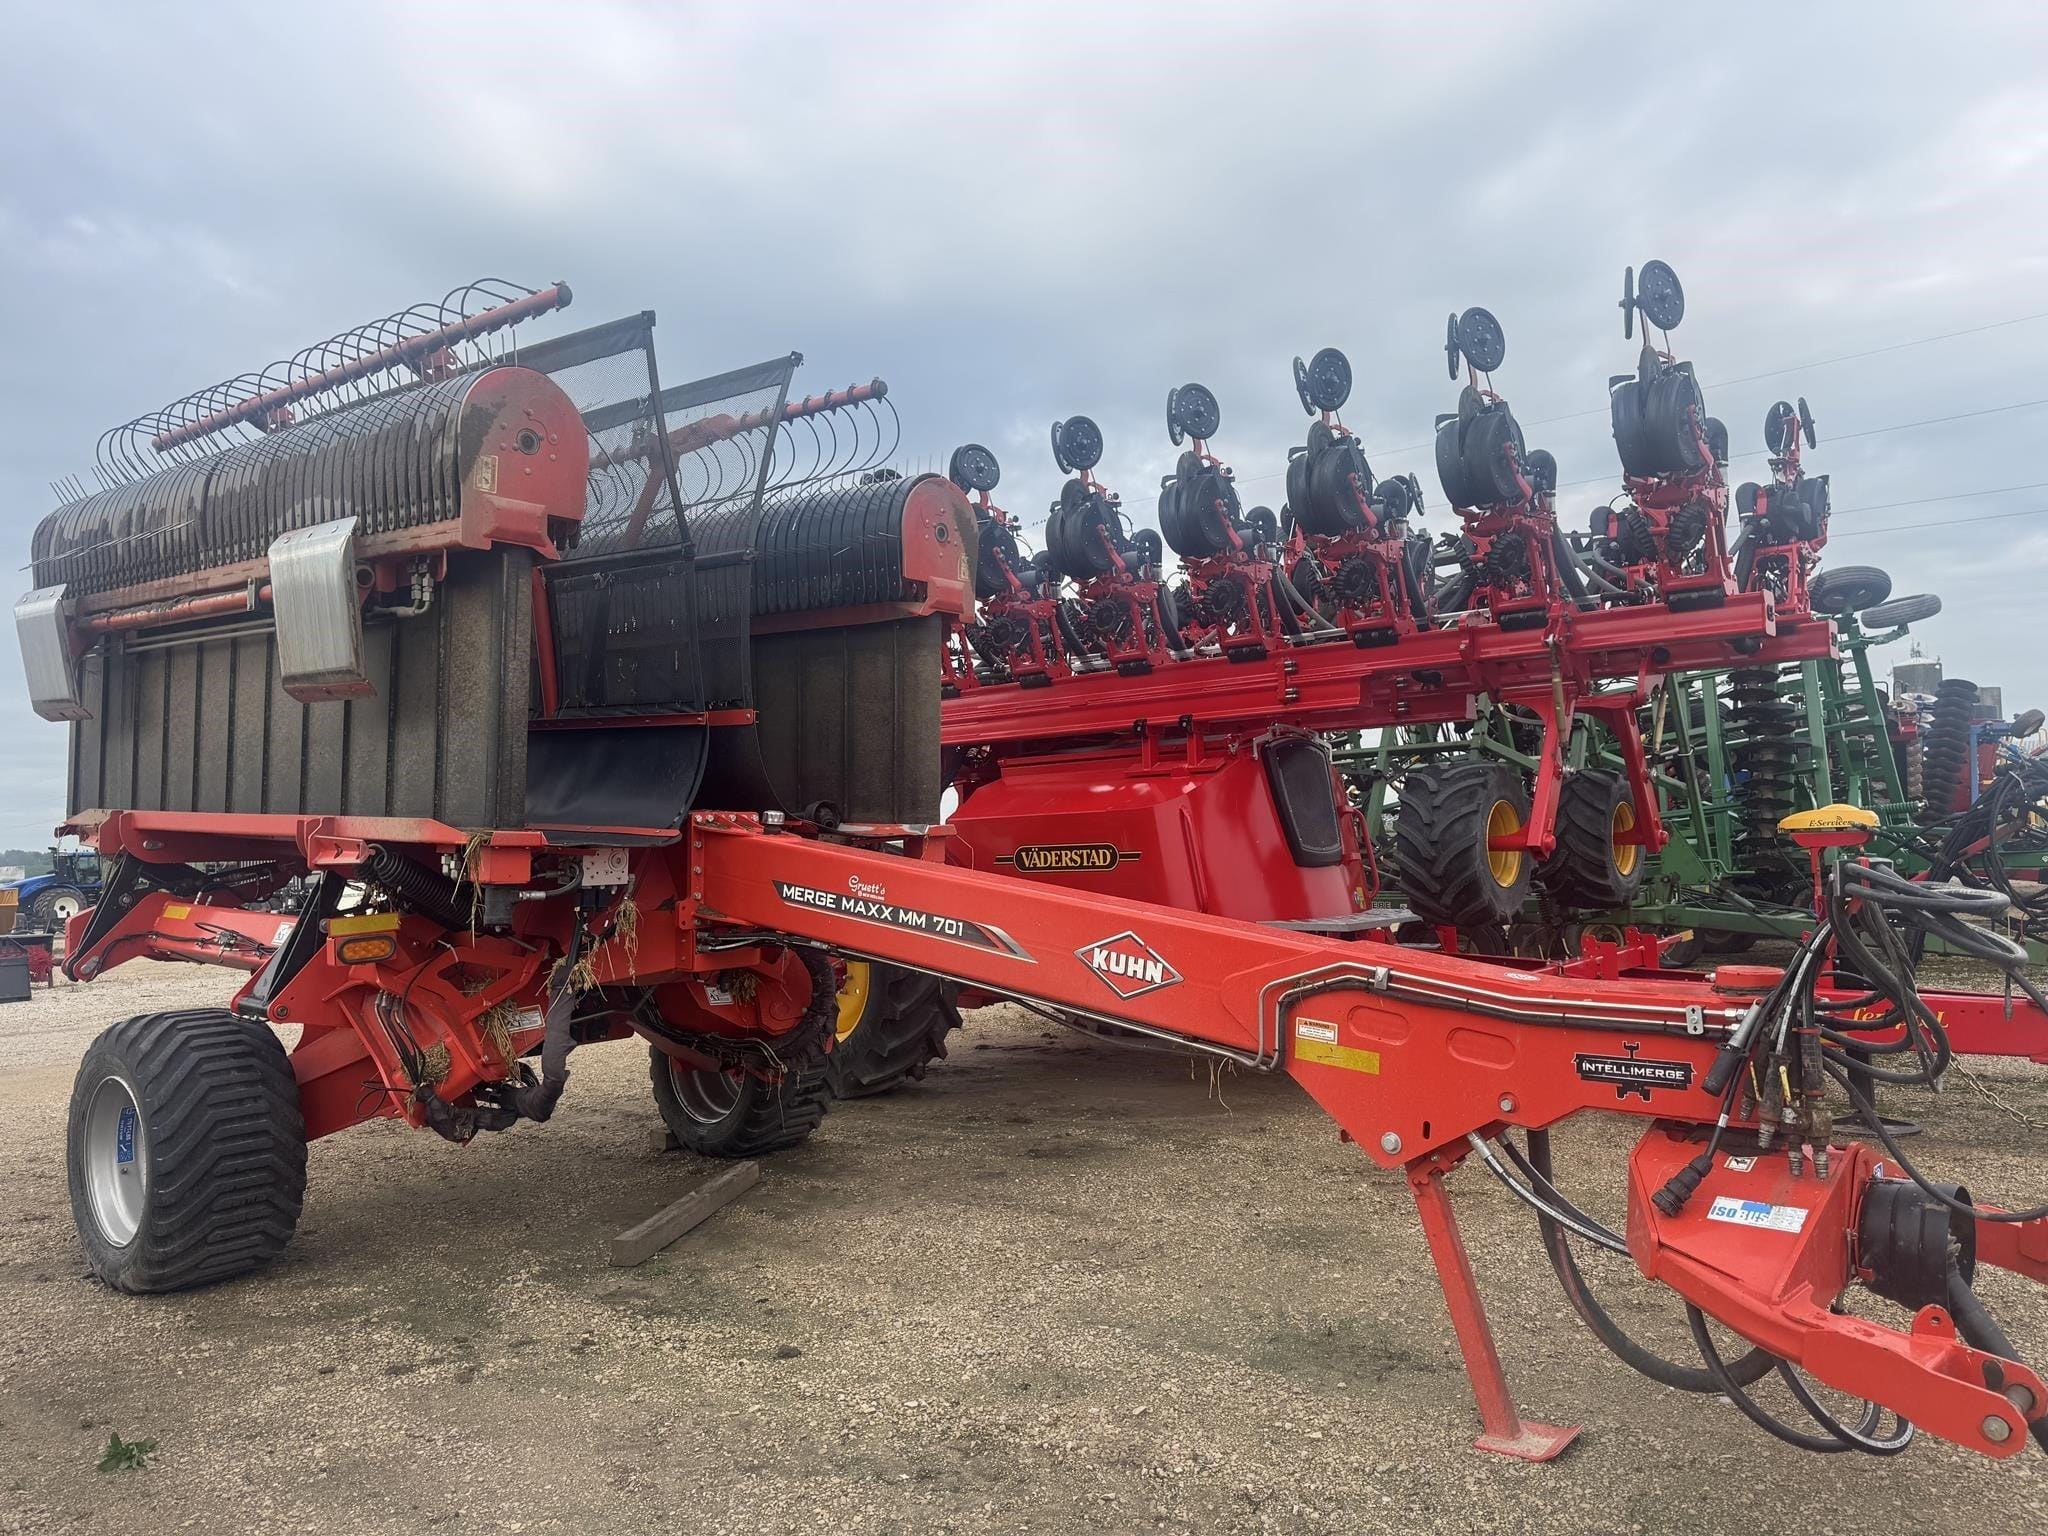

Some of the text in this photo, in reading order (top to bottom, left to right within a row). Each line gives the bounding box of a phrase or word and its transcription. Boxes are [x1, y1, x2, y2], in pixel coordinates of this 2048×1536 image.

[1809, 818, 1851, 827] E-Services
[1020, 848, 1112, 868] VÄDERSTAD
[848, 875, 886, 894] Gruett's
[782, 883, 964, 937] MERGE MAXX MM 701
[1092, 947, 1164, 984] KUHN
[1581, 1061, 1685, 1080] INTELLIMERGE
